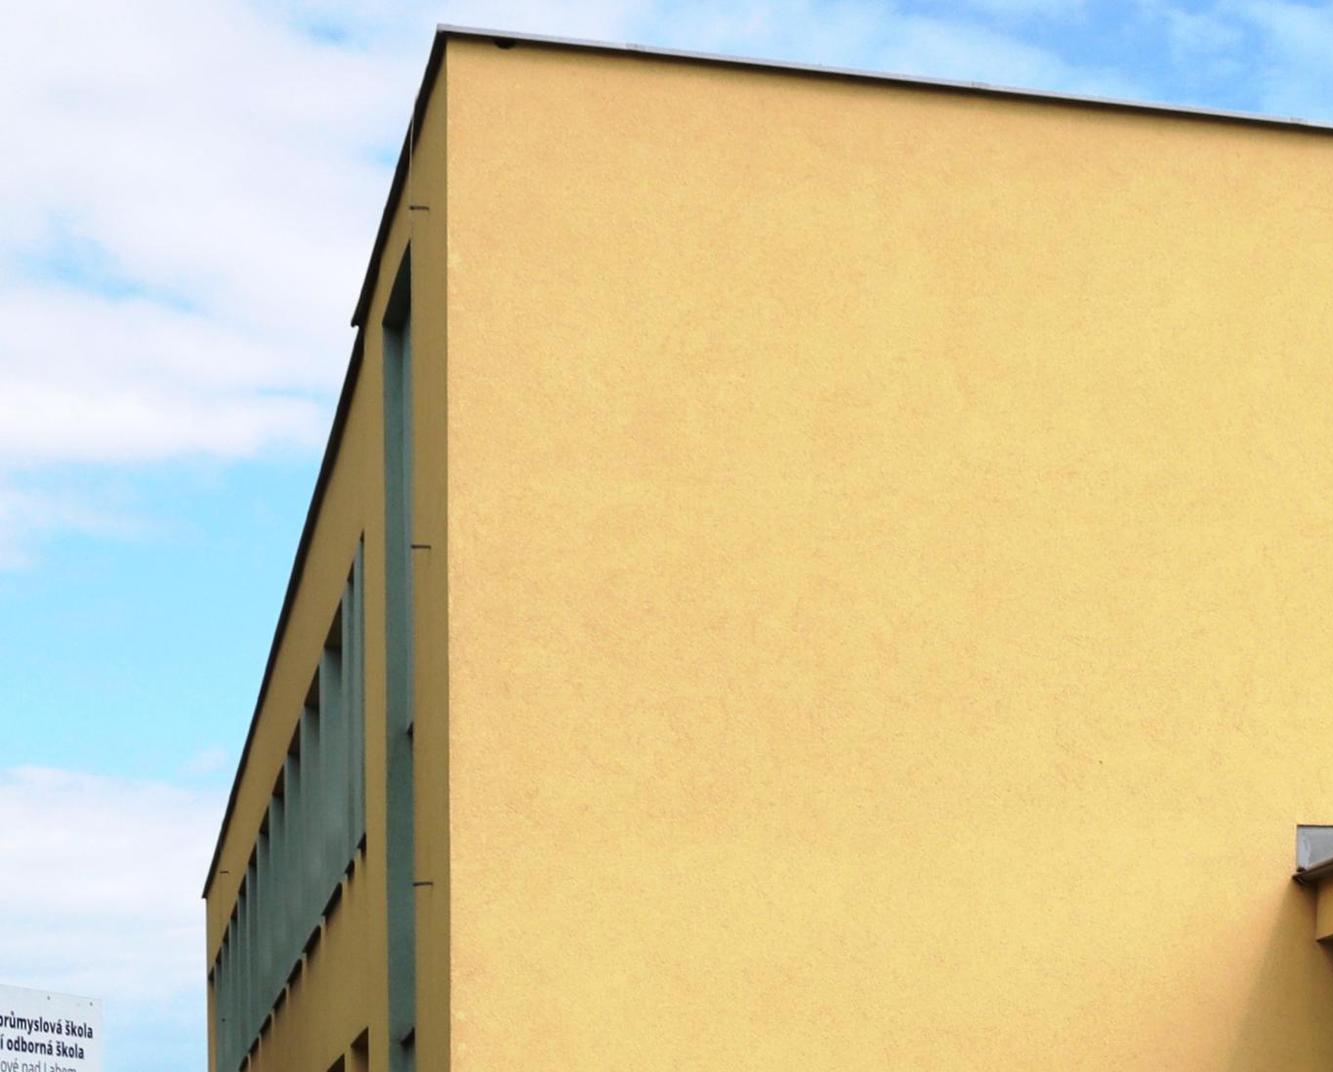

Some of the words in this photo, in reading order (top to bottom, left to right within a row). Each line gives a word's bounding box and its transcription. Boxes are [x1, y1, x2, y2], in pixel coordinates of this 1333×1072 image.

[65, 1020, 93, 1039] škola
[7, 1036, 53, 1056] odborná
[56, 1040, 84, 1059] škola
